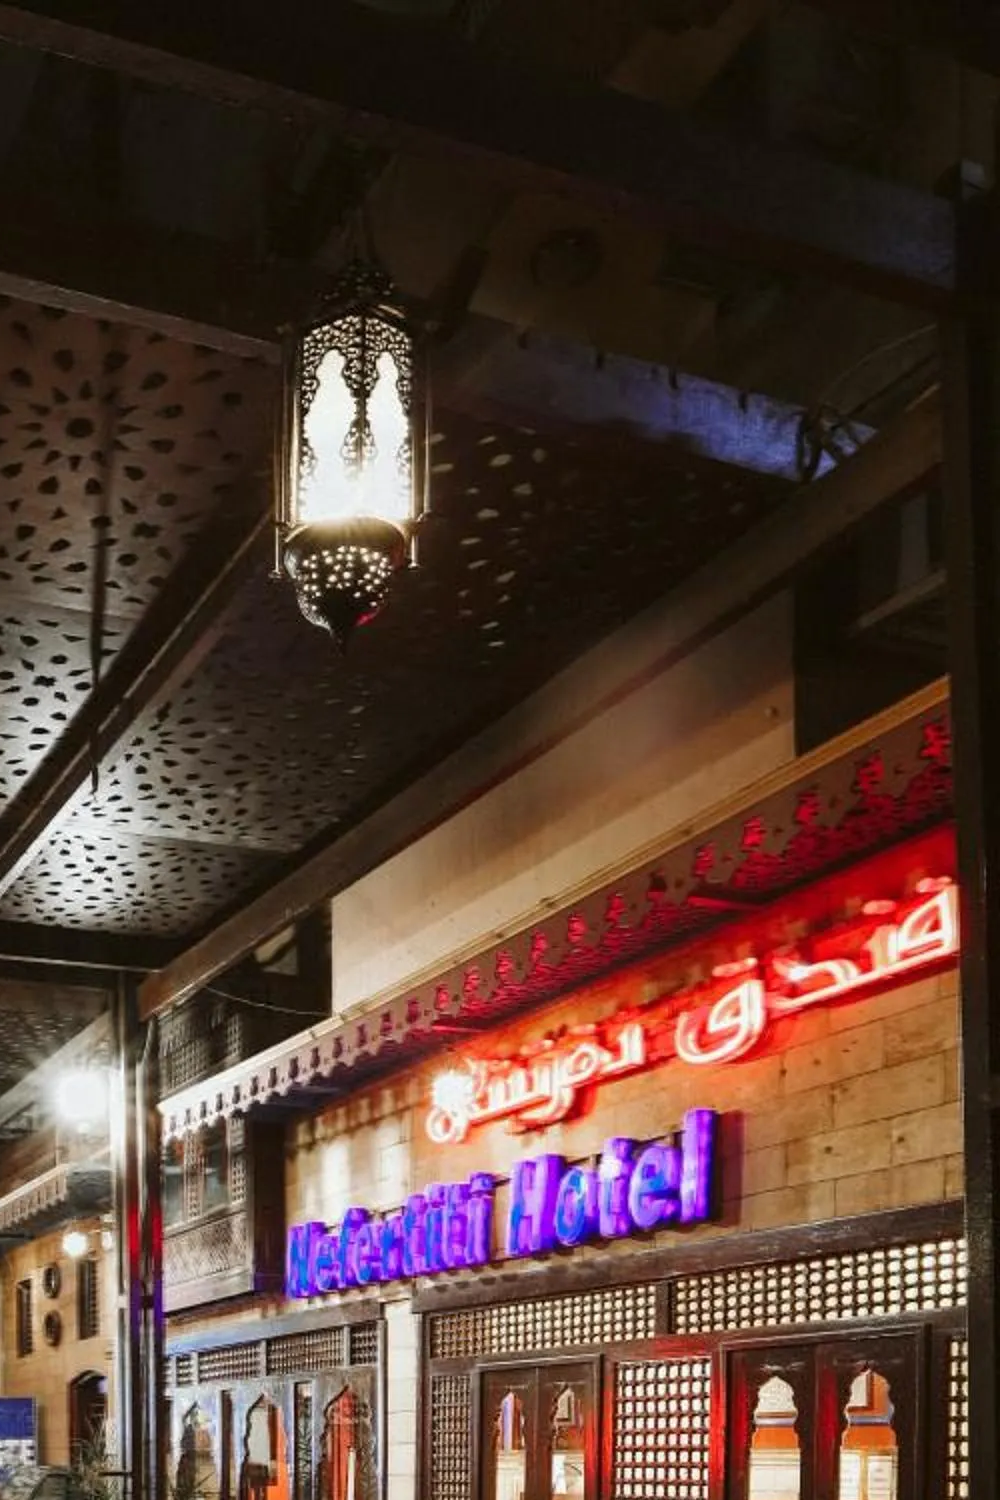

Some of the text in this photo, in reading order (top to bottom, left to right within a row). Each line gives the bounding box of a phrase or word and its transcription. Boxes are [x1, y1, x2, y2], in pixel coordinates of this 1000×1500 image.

[674, 876, 958, 1064] فندق
[287, 1108, 717, 1299] Nefertiti Hotel
